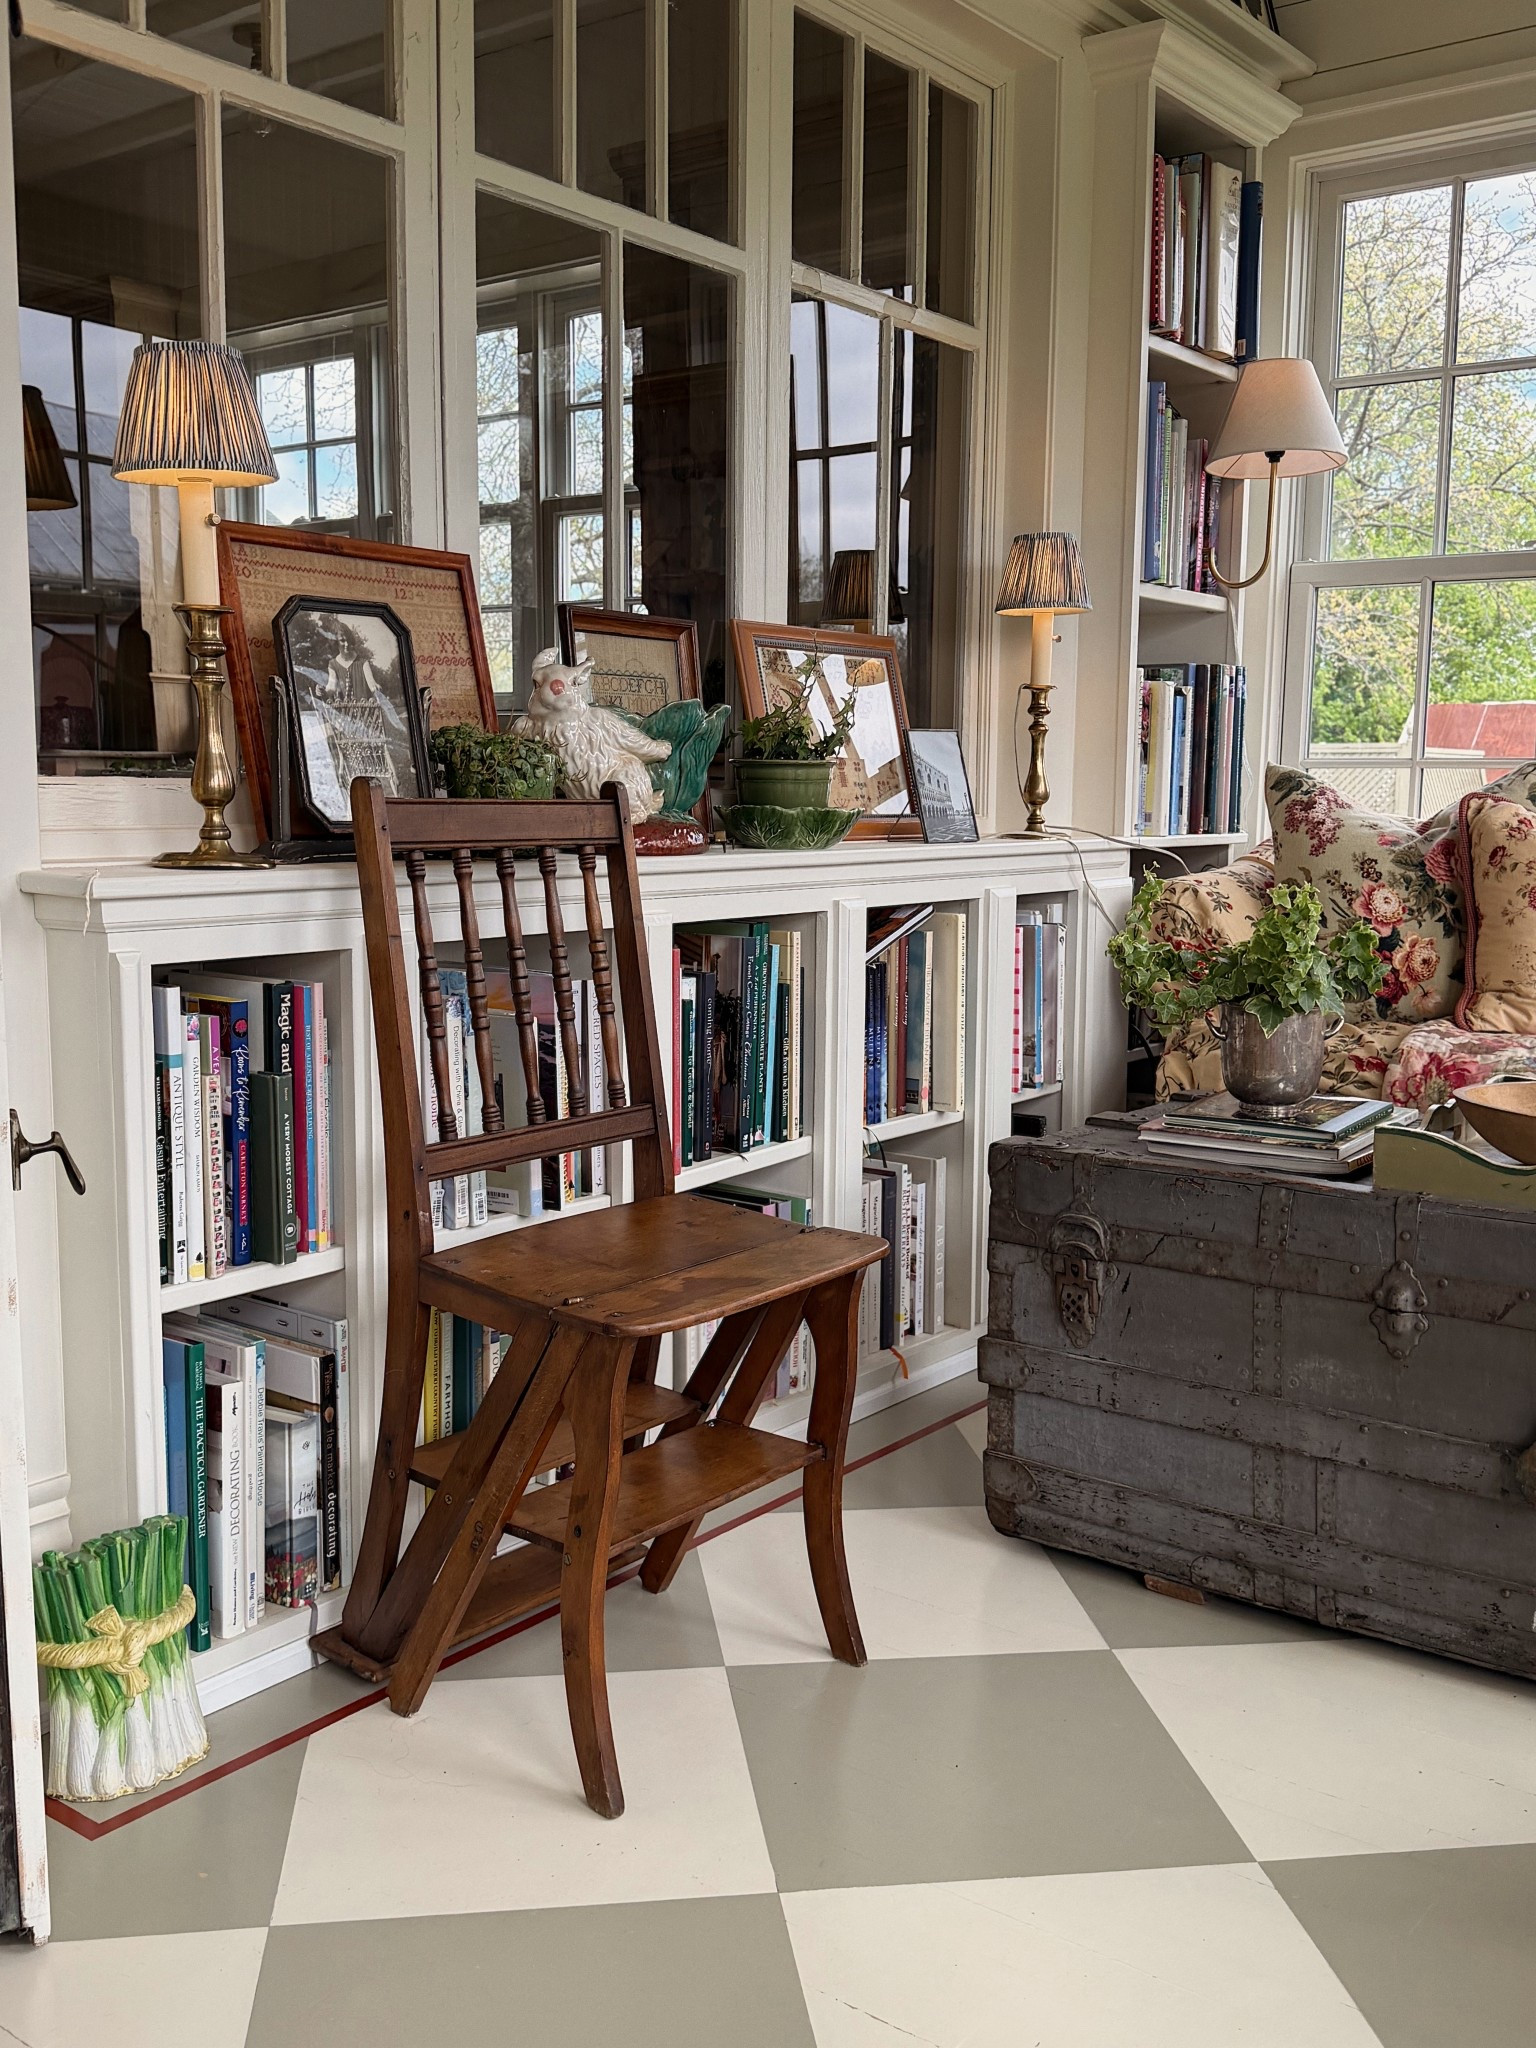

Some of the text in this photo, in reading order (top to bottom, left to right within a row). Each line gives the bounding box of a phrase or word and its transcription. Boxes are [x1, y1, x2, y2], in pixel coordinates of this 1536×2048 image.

[747, 955, 755, 981] French
[761, 961, 769, 1000] GROWING
[745, 981, 754, 1011] Country
[752, 991, 760, 1040] PERENNIALS
[277, 992, 292, 1074] Magic and
[452, 1025, 461, 1067] Decorating
[705, 997, 715, 1065] coming home
[744, 1011, 753, 1039] Cottage
[759, 1024, 767, 1062] FAVORITE
[782, 1037, 790, 1056] Gifts
[231, 1044, 250, 1132] Rooms to Remember
[594, 1043, 603, 1090] SPACES
[758, 1063, 766, 1094] PLANTS
[193, 1056, 202, 1139] GARDEN WISDOM
[781, 1088, 789, 1118] Kitchen
[172, 1075, 185, 1170] ANTIQUE STYLE
[156, 1135, 168, 1240] Casual Entertaining
[240, 1144, 249, 1221] CARLETON VARNEY
[861, 1198, 869, 1228] Magnolia
[900, 1224, 908, 1269] RETREATS
[935, 1224, 945, 1291] ABODE
[257, 1387, 265, 1417] Debbie
[257, 1419, 265, 1445] Travis'
[195, 1397, 207, 1539] THE PRACTICAL GARDENER
[230, 1449, 241, 1537] DECORATING
[326, 1429, 338, 1558] flea market decorating
